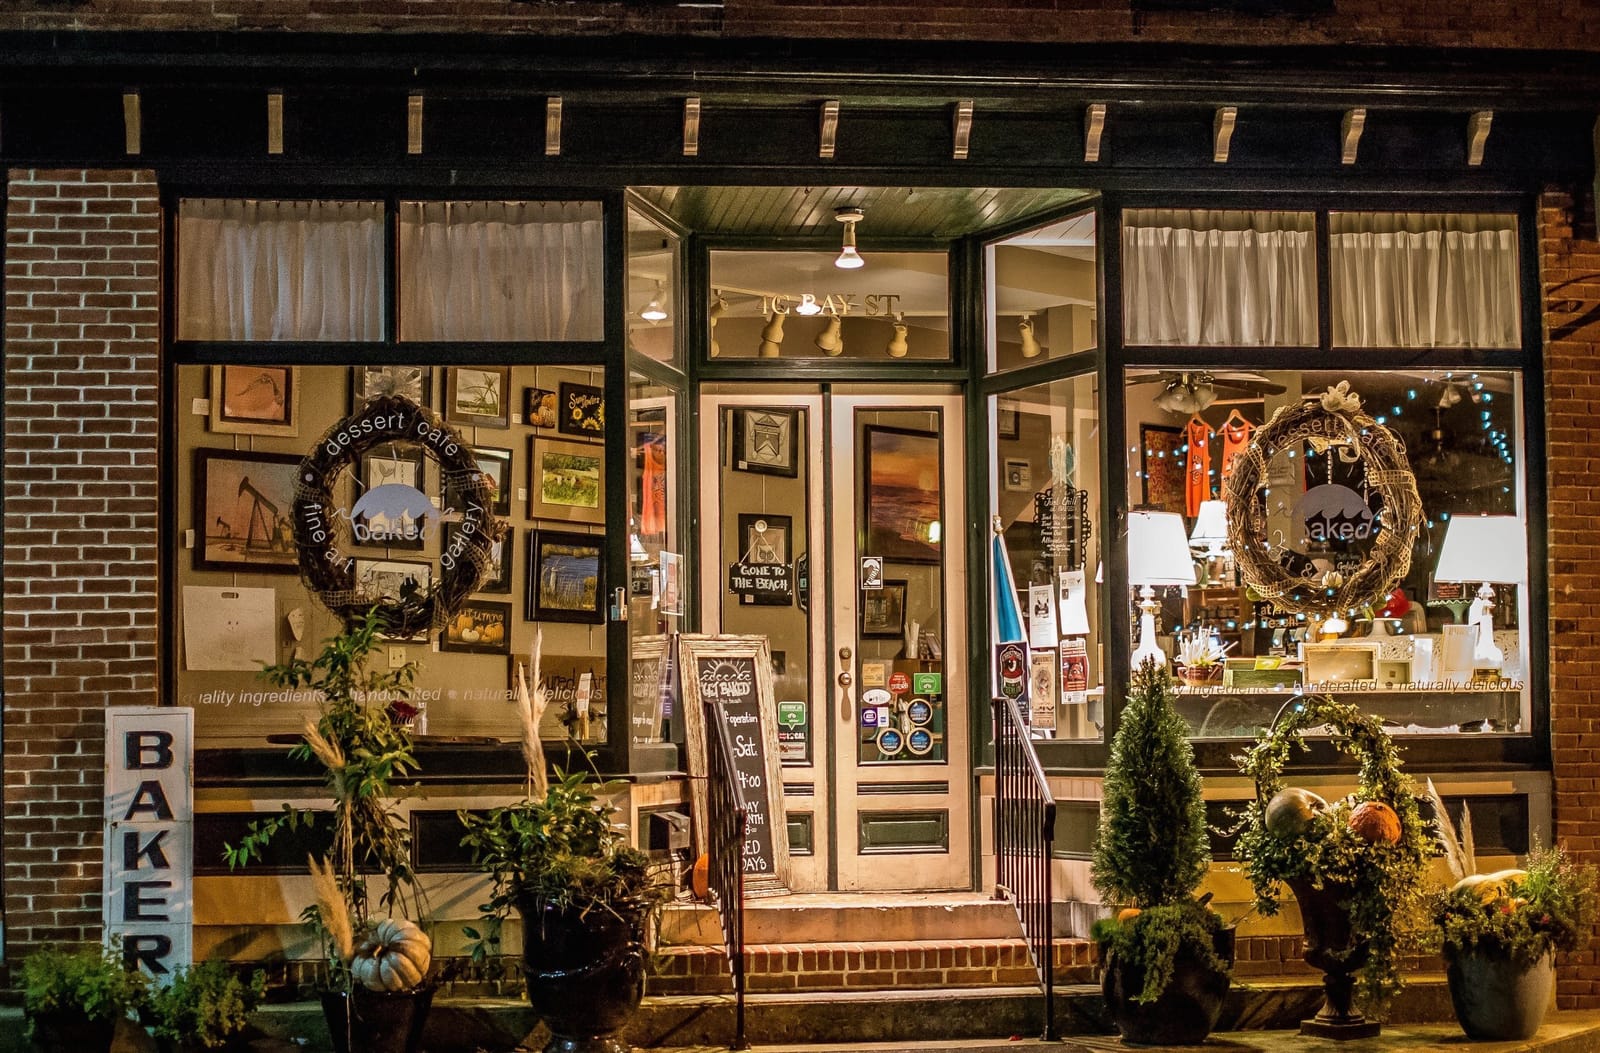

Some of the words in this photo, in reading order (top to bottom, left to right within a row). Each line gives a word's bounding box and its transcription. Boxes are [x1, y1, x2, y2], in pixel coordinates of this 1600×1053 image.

[801, 294, 856, 315] BAY
[326, 412, 405, 456] dessert
[417, 421, 458, 456] cafe
[303, 502, 326, 543] fine
[351, 516, 441, 541] baked
[439, 501, 483, 570] gallery
[325, 547, 354, 574] art
[740, 565, 770, 576] GONE
[771, 565, 786, 576] TO
[731, 577, 754, 589] THE
[755, 578, 788, 591] BEACH
[1398, 678, 1460, 694] naturally
[1463, 677, 1525, 692] delicious
[238, 688, 327, 707] ingredients
[463, 687, 522, 702] naturall
[729, 711, 758, 727] operation
